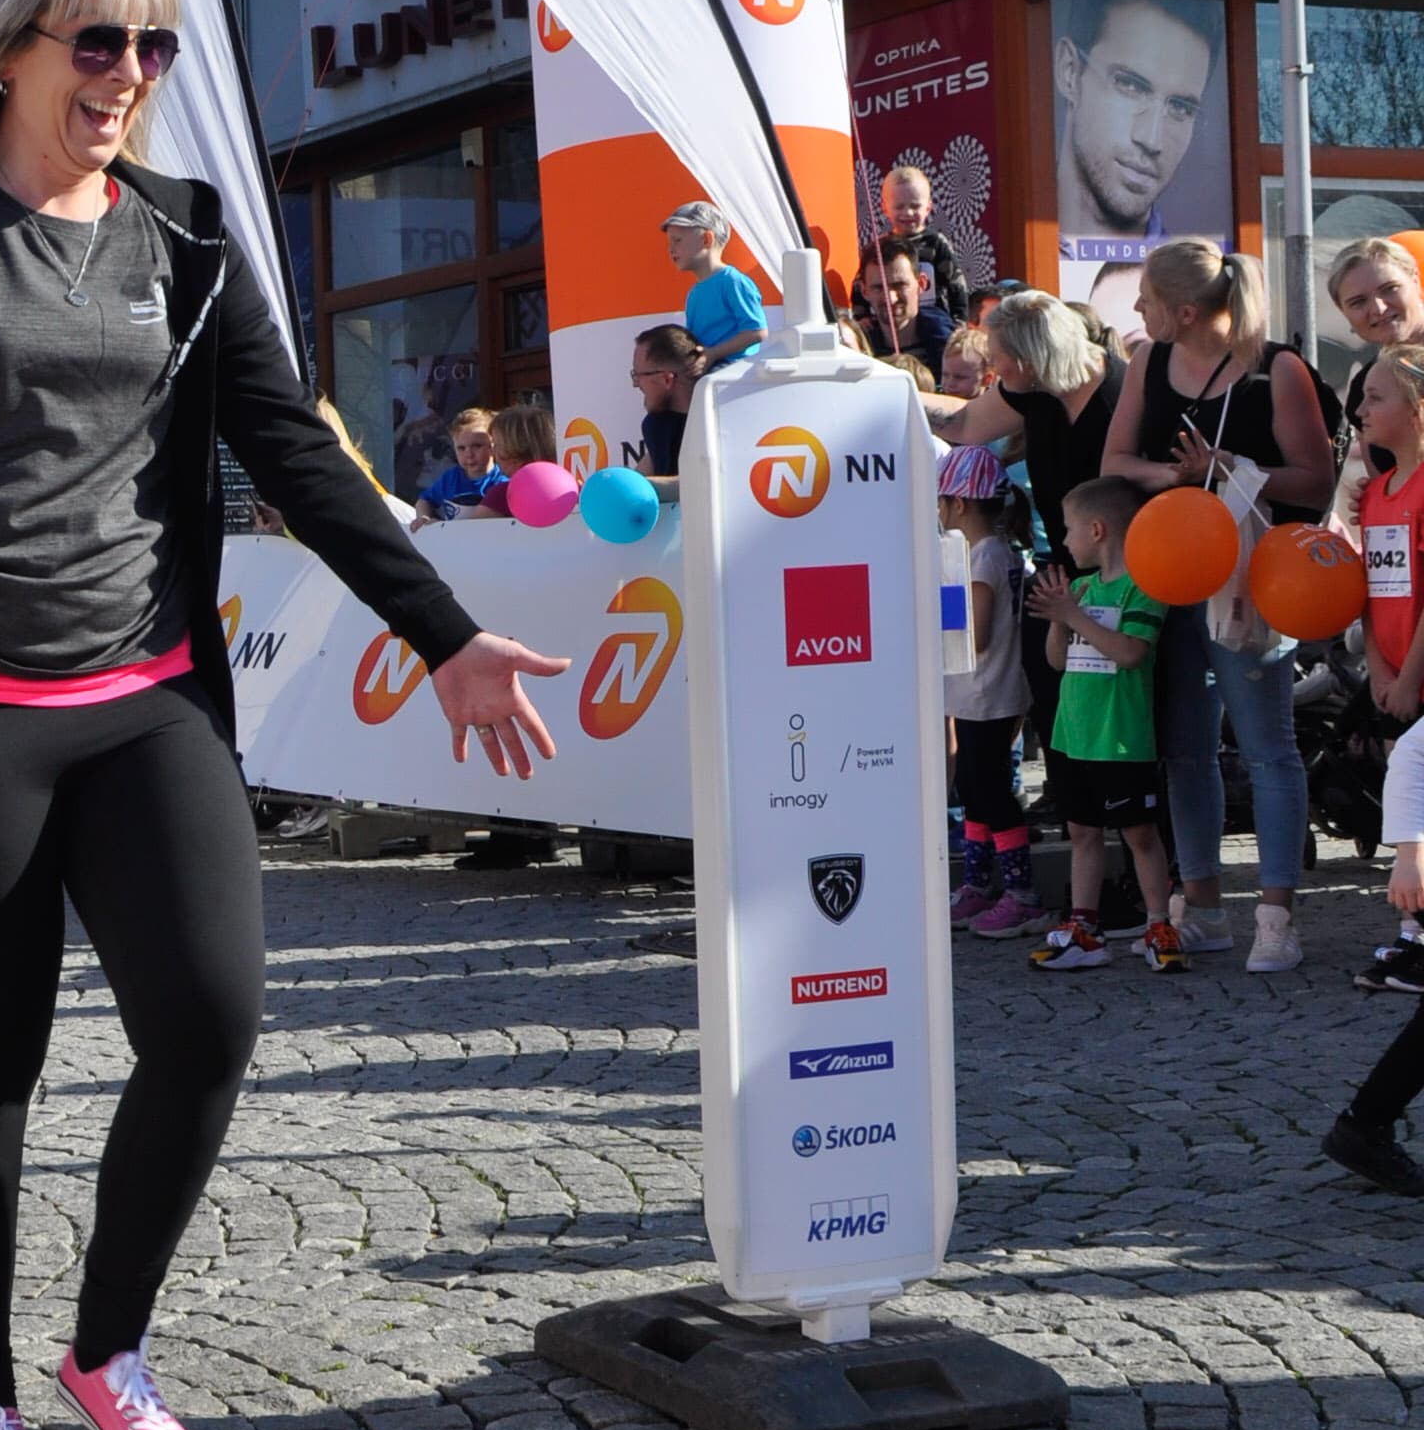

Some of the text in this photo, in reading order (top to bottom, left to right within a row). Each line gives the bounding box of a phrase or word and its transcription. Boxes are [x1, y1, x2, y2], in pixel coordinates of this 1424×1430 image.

[874, 37, 941, 66] OPTIKA
[853, 60, 990, 118] UNETTES
[1080, 244, 1147, 258] LINDB
[845, 453, 897, 483] NN
[1368, 550, 1406, 569] 3042
[232, 631, 287, 670] NN
[794, 635, 863, 658] AVON
[856, 745, 894, 757] Powered
[857, 757, 894, 770] by MVM
[769, 792, 828, 809] innogy
[812, 859, 859, 870] PEUGEOT
[796, 973, 884, 998] NUTREND
[824, 1122, 897, 1149] ŠKODA
[807, 1211, 887, 1242] KPMG
